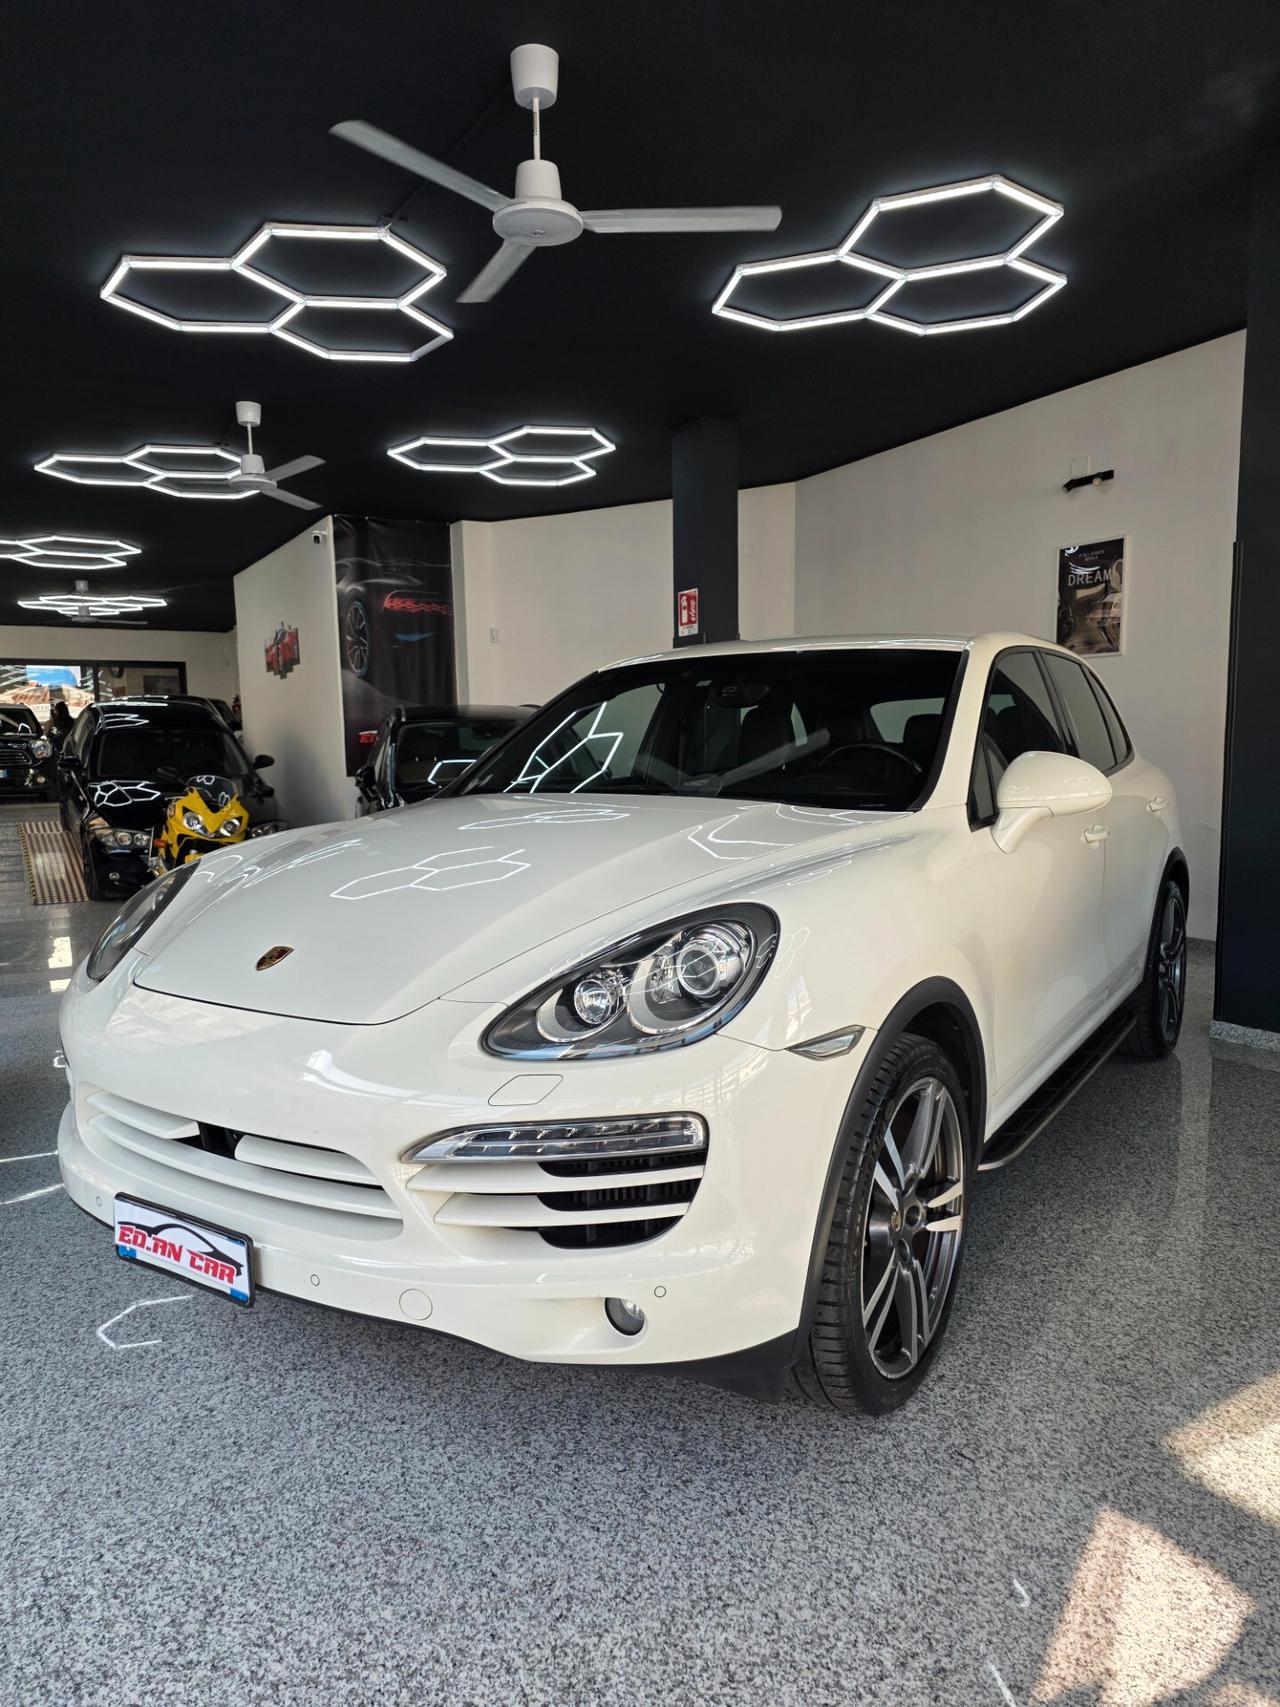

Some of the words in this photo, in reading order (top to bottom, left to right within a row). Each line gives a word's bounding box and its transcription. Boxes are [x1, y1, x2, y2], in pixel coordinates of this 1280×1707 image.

[1068, 568, 1112, 586] DREAM
[118, 1226, 183, 1262] ED.AN
[188, 1250, 235, 1283] CAR
